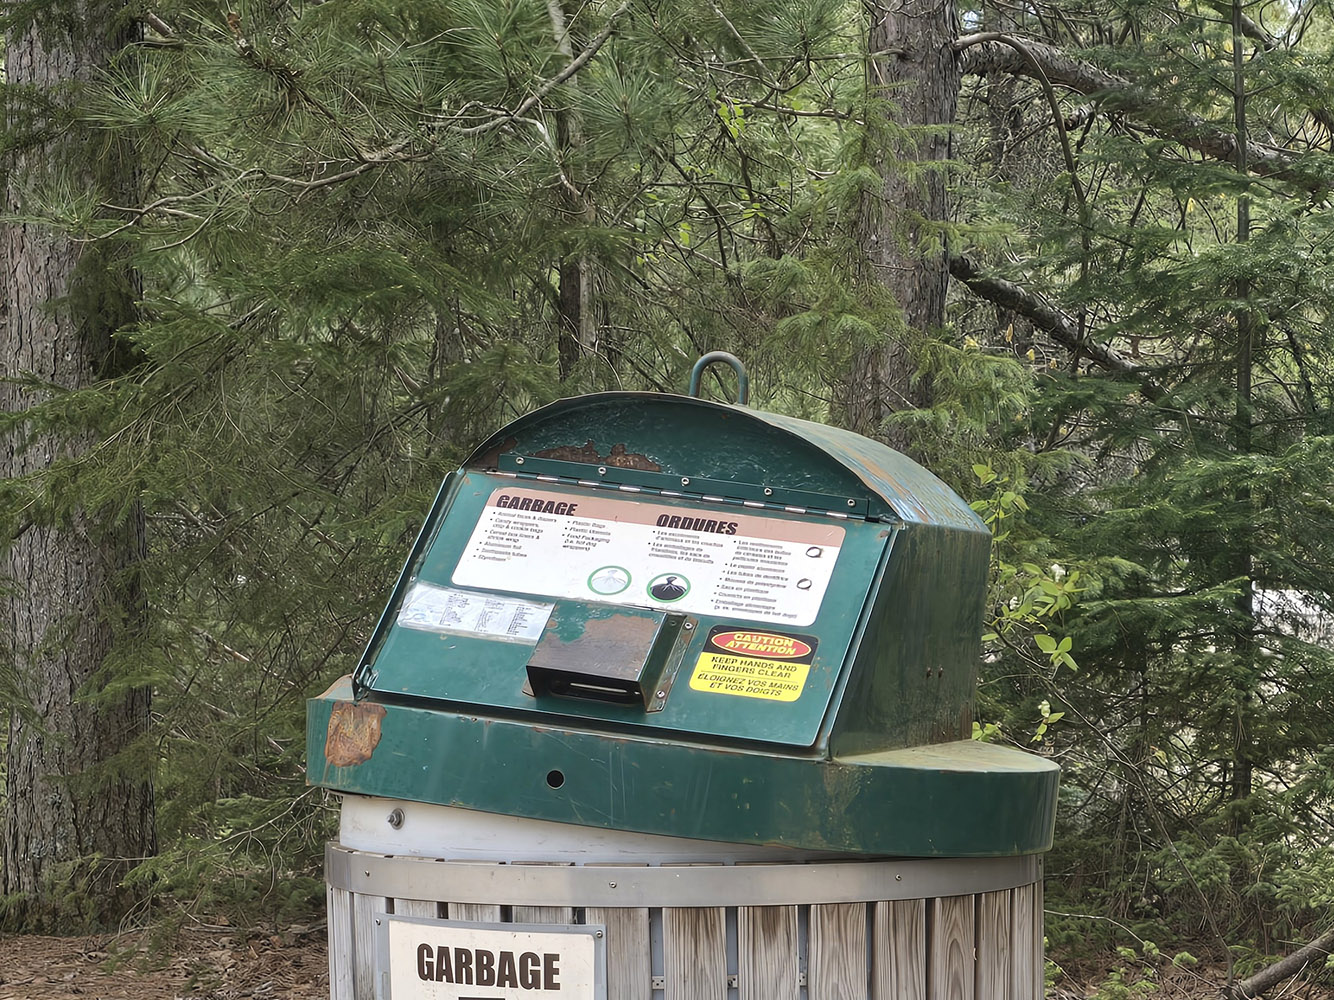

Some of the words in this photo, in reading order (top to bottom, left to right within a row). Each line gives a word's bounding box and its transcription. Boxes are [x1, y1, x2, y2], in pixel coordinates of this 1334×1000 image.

[496, 495, 578, 516] GARBAGE
[656, 514, 738, 535] ORDURES
[734, 634, 794, 647] CAUTION
[725, 642, 797, 655] ATTENTION
[711, 656, 738, 664] KEEP
[739, 660, 774, 669] HANDS
[776, 664, 798, 672] AND
[712, 664, 755, 674] FINGERS
[757, 669, 791, 679] CLEAR
[725, 684, 745, 692] VOS
[745, 686, 782, 696] DOIGTS
[748, 679, 767, 687] VOS
[768, 682, 799, 691] MAINS
[416, 942, 561, 991] GARBAGE
